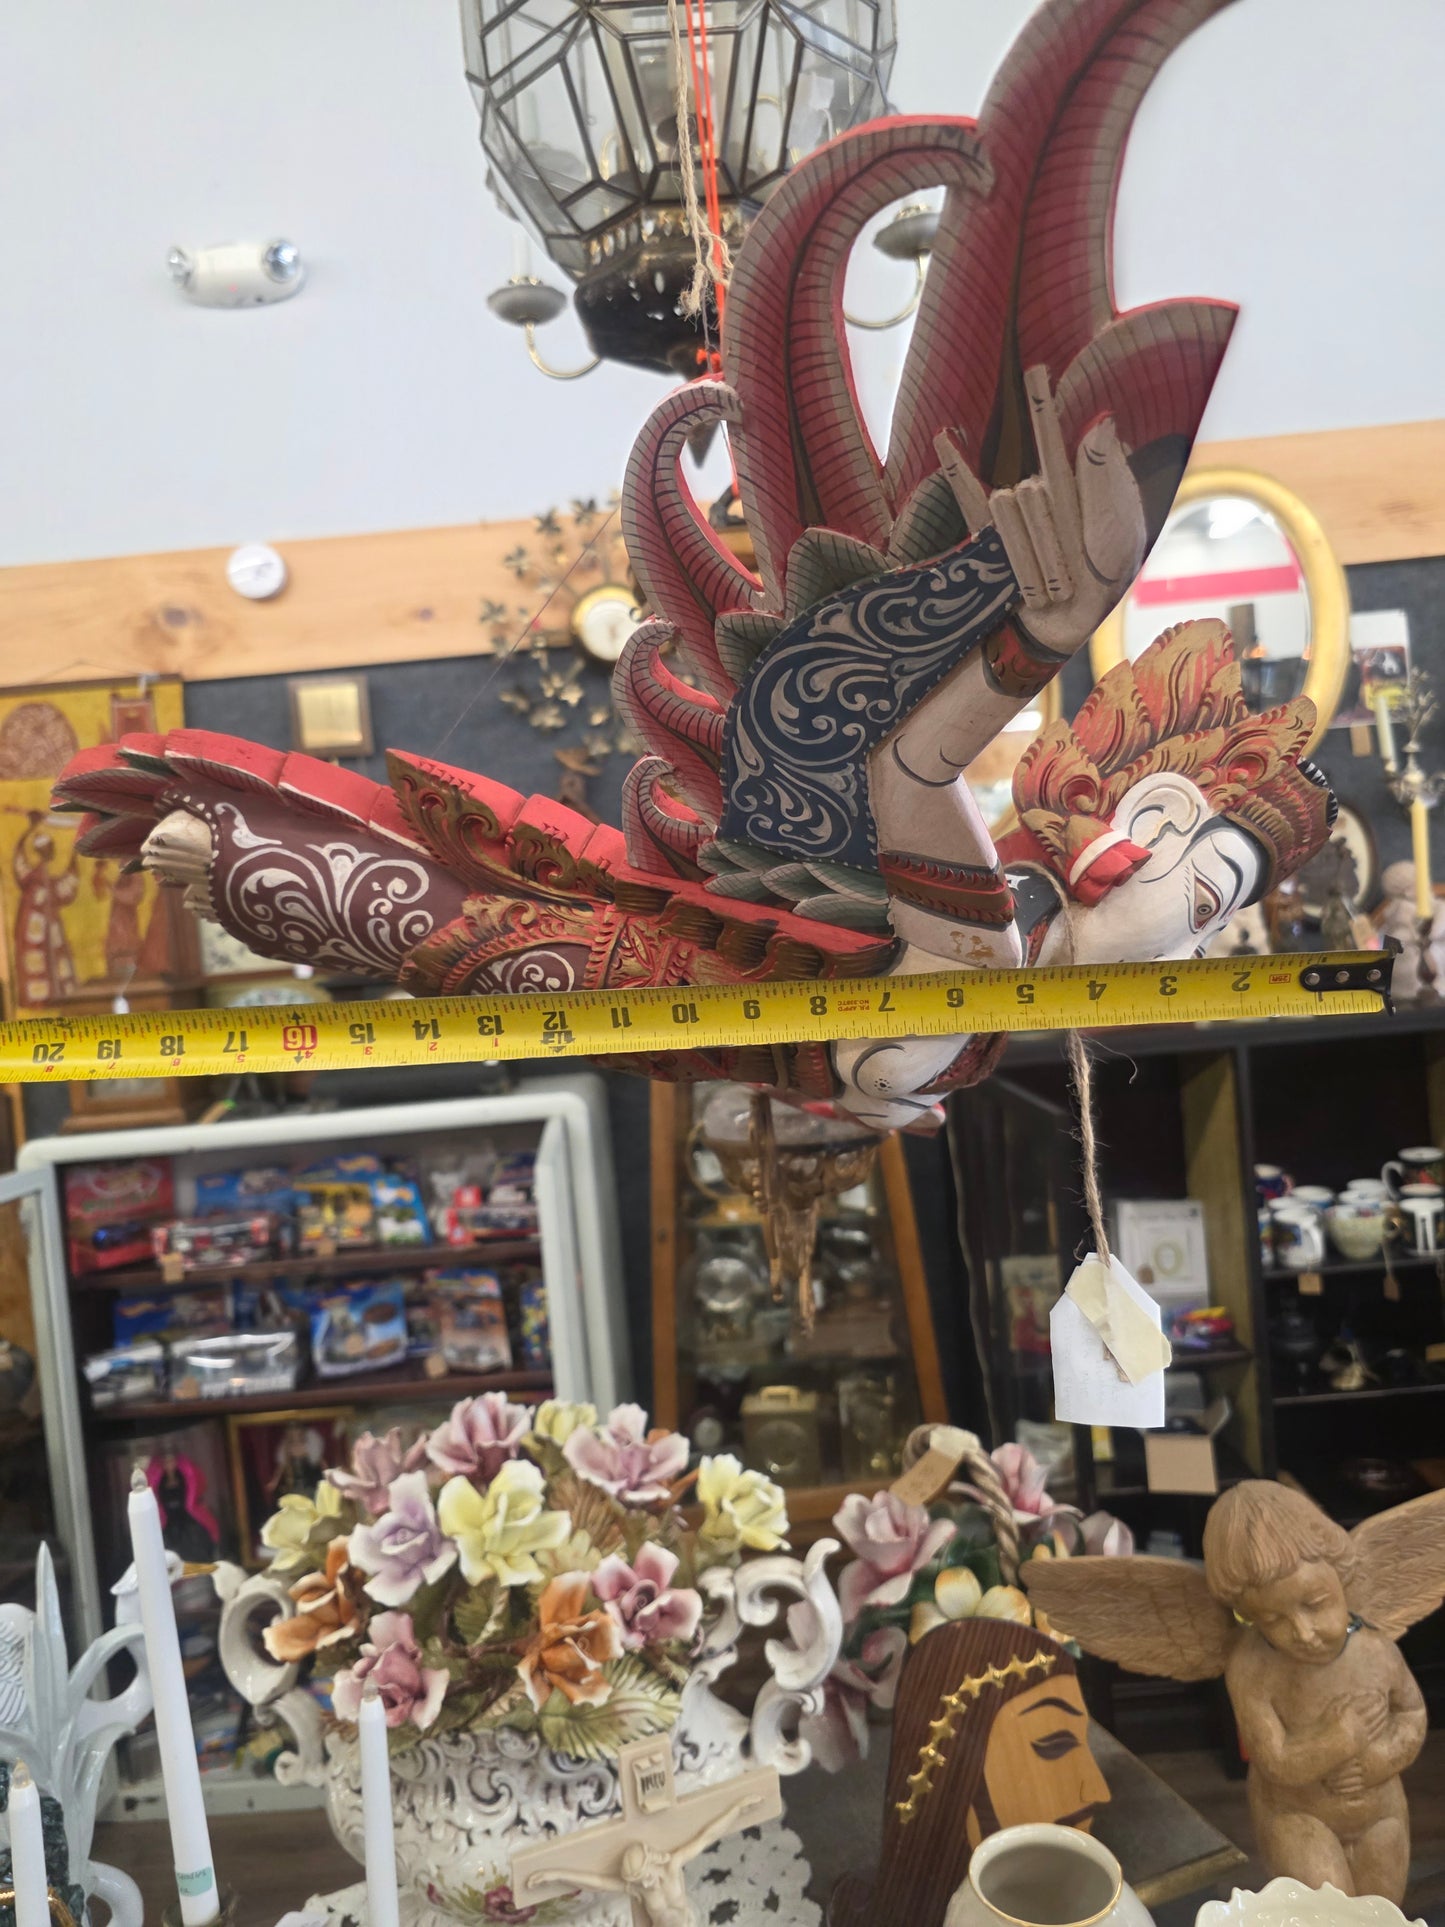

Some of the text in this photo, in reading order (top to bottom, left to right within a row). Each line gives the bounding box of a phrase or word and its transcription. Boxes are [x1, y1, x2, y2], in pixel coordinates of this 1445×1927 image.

[1086, 980, 1107, 1001] 4
[1159, 975, 1178, 996] 3
[1231, 971, 1251, 992] 2
[878, 991, 896, 1012] 7
[946, 988, 964, 1008] 6
[1016, 984, 1035, 1004] 5
[671, 1002, 700, 1024] 10
[743, 999, 761, 1019] 9
[809, 995, 827, 1016] 8
[477, 1015, 505, 1036] 13
[542, 1011, 569, 1030] 12
[611, 1006, 632, 1028] 11
[286, 1026, 315, 1050] 16
[349, 1022, 376, 1045] 15
[412, 1018, 442, 1041] 14
[97, 1039, 123, 1060] 19
[160, 1034, 186, 1056] 18
[222, 1030, 249, 1053] 17
[364, 1046, 373, 1055] 3
[428, 1041, 438, 1051] 2
[493, 1037, 499, 1047] 1
[32, 1042, 65, 1064] 20
[236, 1053, 246, 1063] 5
[304, 1050, 314, 1059] 4
[108, 1062, 116, 1070] 7
